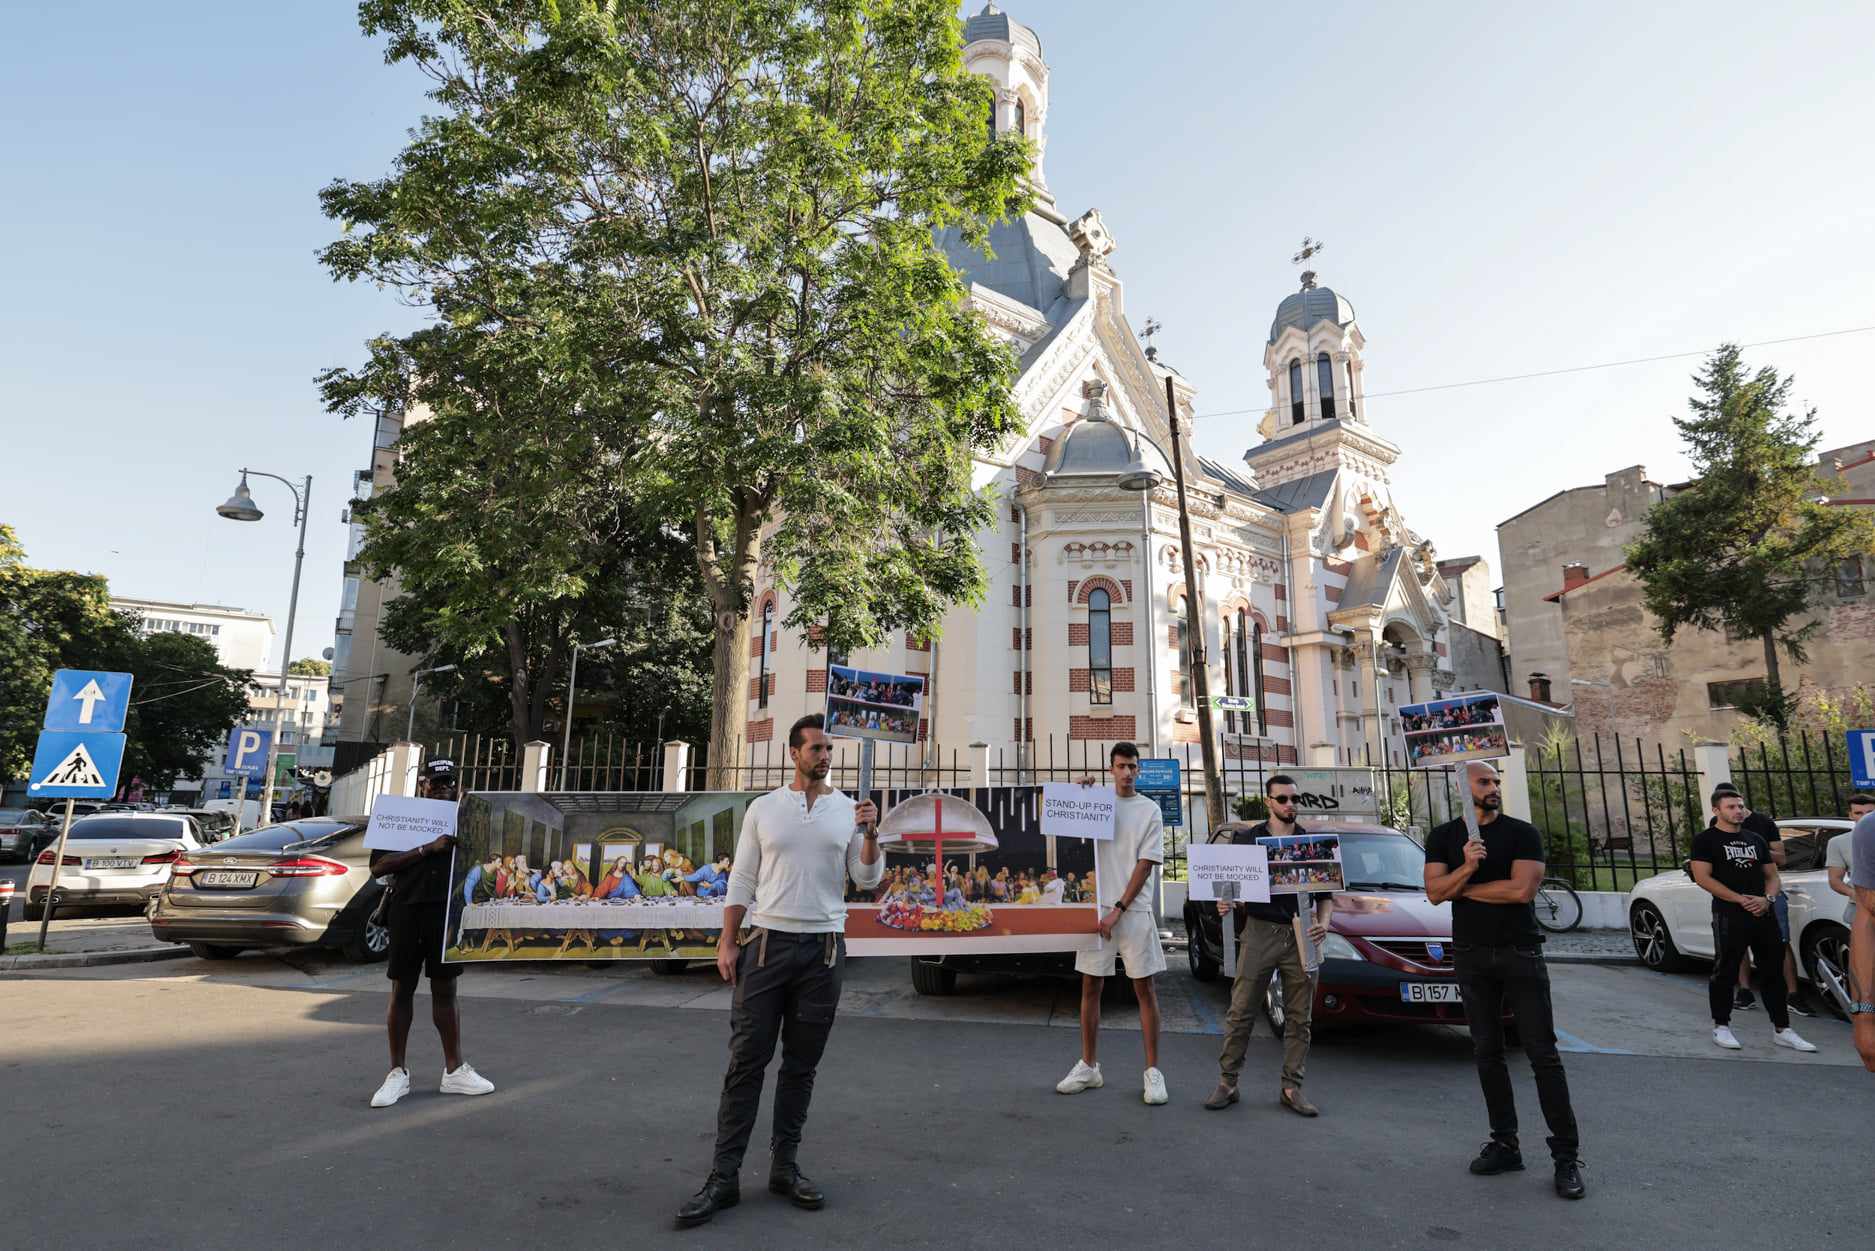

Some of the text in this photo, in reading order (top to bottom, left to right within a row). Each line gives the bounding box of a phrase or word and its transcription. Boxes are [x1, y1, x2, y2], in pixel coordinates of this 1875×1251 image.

[235, 731, 260, 769] P
[1046, 799, 1112, 812] STAND-UP FOR
[376, 814, 430, 825] CHRISTIANITY
[1047, 810, 1111, 821] CHRISTIANITY
[409, 825, 443, 833] MOCKED
[1193, 864, 1264, 873] CHRISTIANITY WILL
[208, 873, 253, 885] B 124 XMX
[1227, 873, 1260, 881] MOCKED
[1412, 985, 1423, 1000] B
[1428, 986, 1449, 1000] 157
